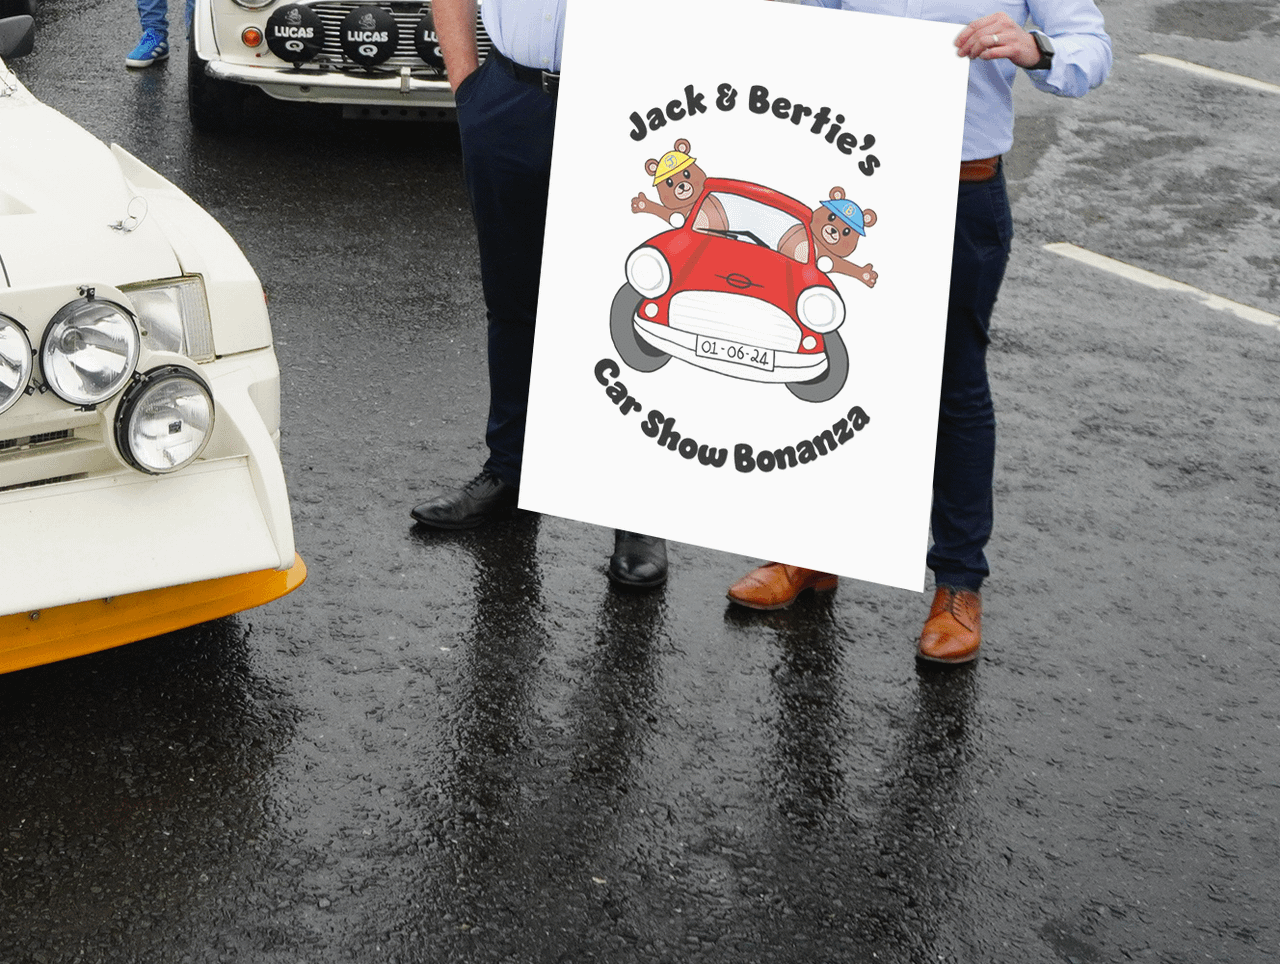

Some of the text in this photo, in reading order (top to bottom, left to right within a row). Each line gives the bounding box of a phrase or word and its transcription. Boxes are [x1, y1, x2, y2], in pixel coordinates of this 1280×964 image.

[274, 25, 314, 39] LUCAS
[347, 30, 389, 43] LUCAS
[285, 40, 305, 52] Q
[358, 44, 378, 57] Q
[629, 83, 881, 177] Jack & Bertie's
[594, 358, 871, 474] Car Show Bonanza
